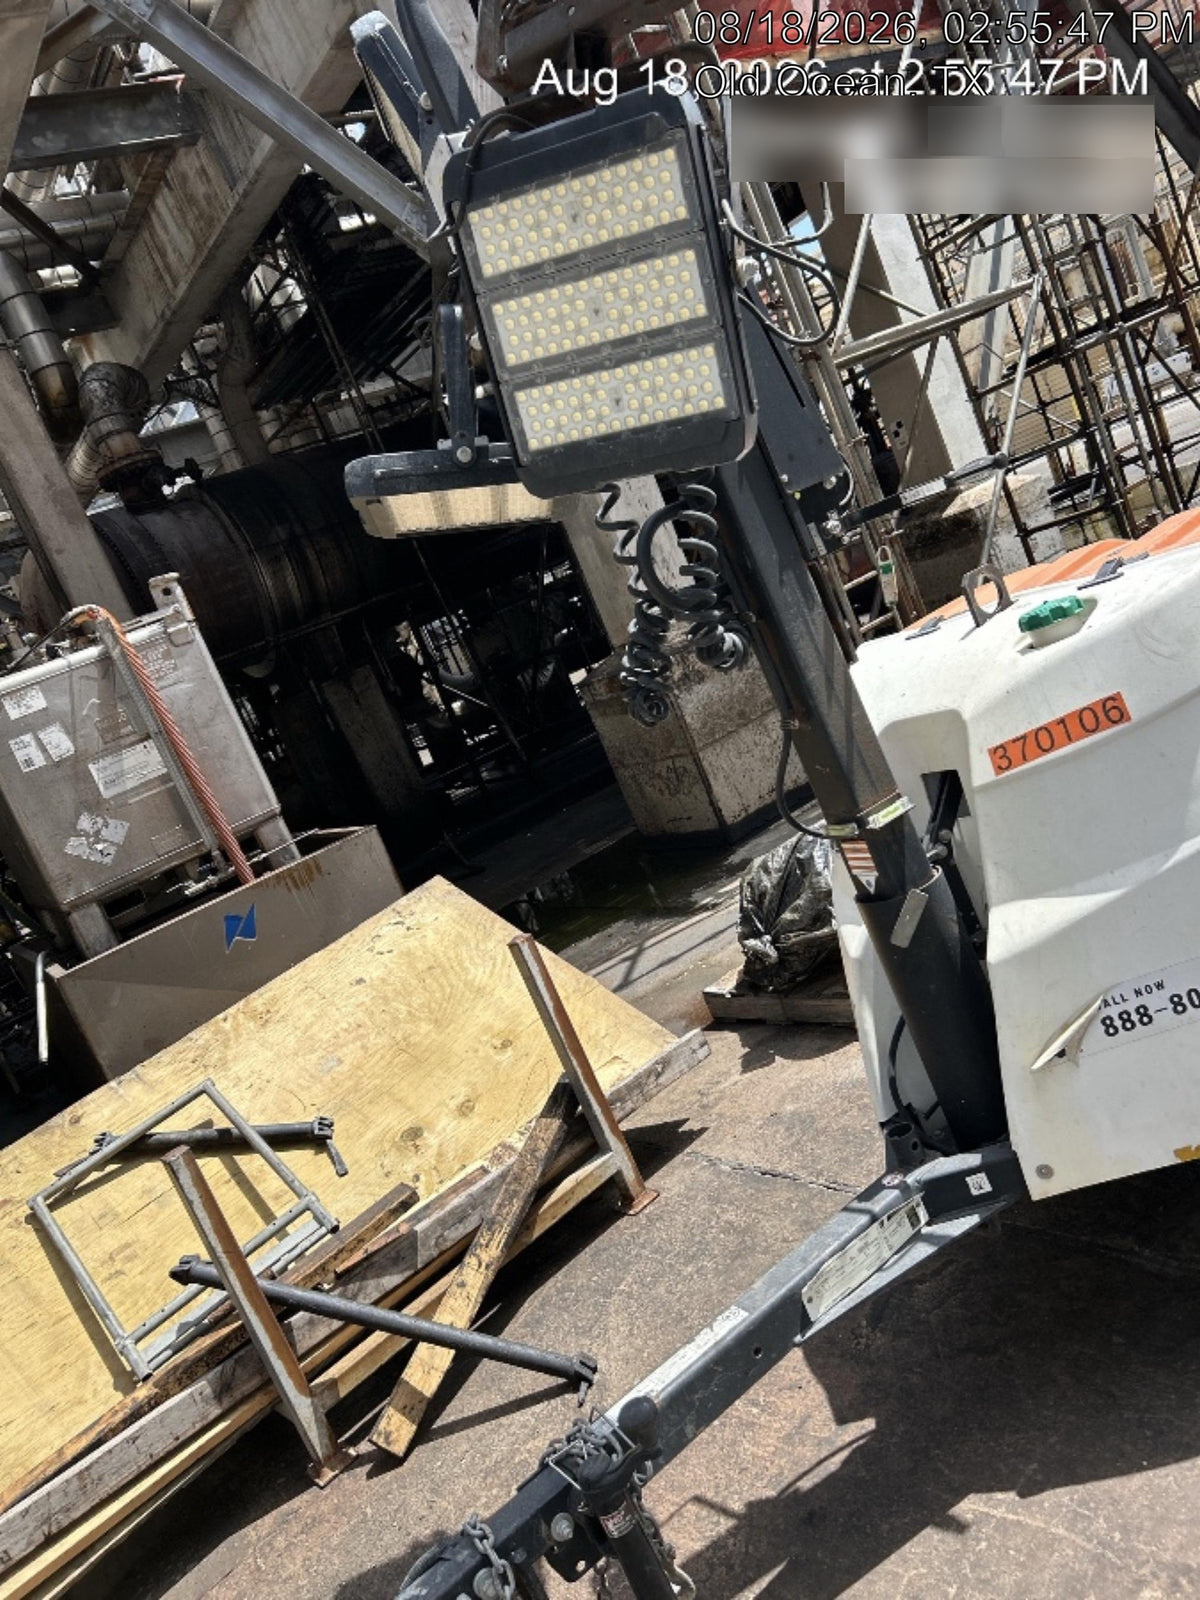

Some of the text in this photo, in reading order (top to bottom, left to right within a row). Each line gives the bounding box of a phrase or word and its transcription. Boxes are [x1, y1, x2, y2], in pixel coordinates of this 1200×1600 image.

[993, 696, 1125, 771] 370106
[1098, 979, 1165, 1011] ALL NOW
